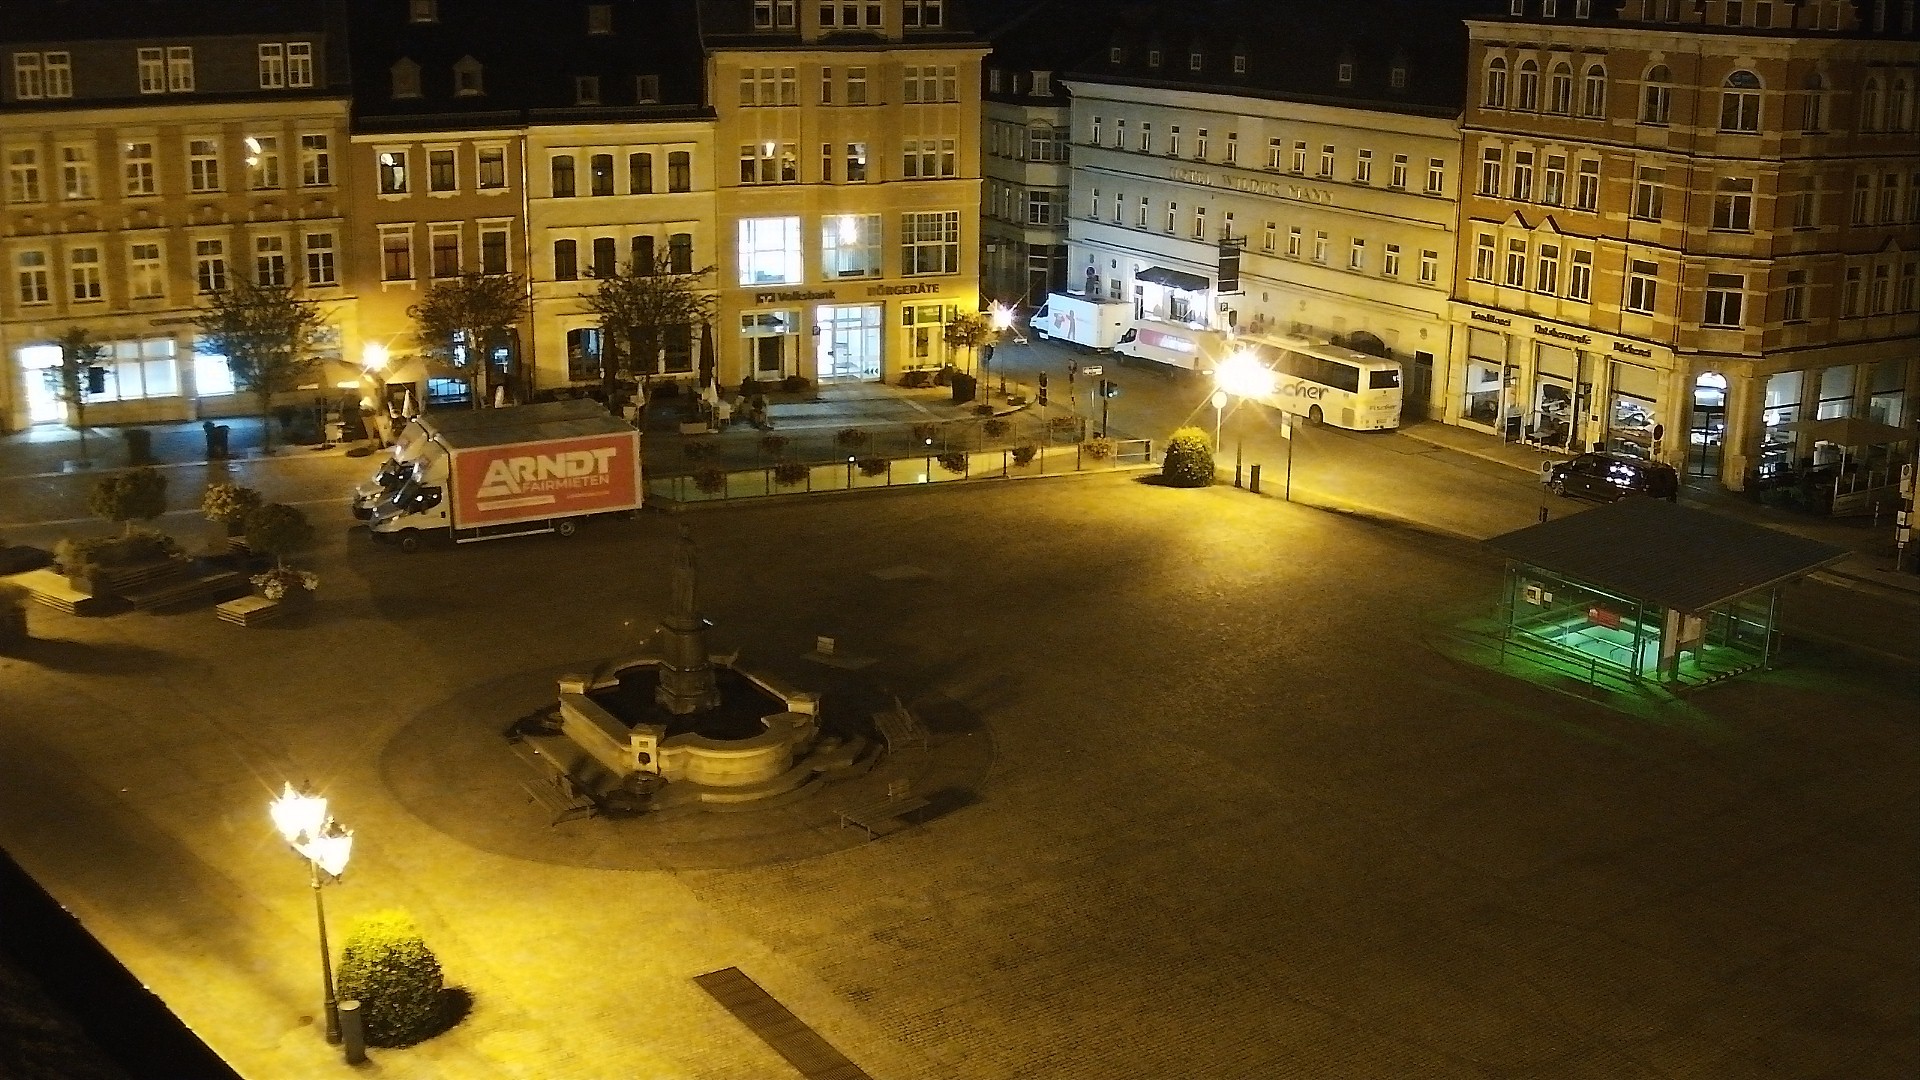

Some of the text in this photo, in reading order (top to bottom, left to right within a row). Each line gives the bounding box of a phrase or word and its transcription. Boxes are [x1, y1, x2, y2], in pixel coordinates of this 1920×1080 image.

[1222, 174, 1280, 196] WILDER
[1288, 183, 1334, 204] MANN
[777, 289, 836, 301] Volksbank
[476, 447, 617, 499] ARNDT
[522, 474, 610, 493] FAIRMIETEN
